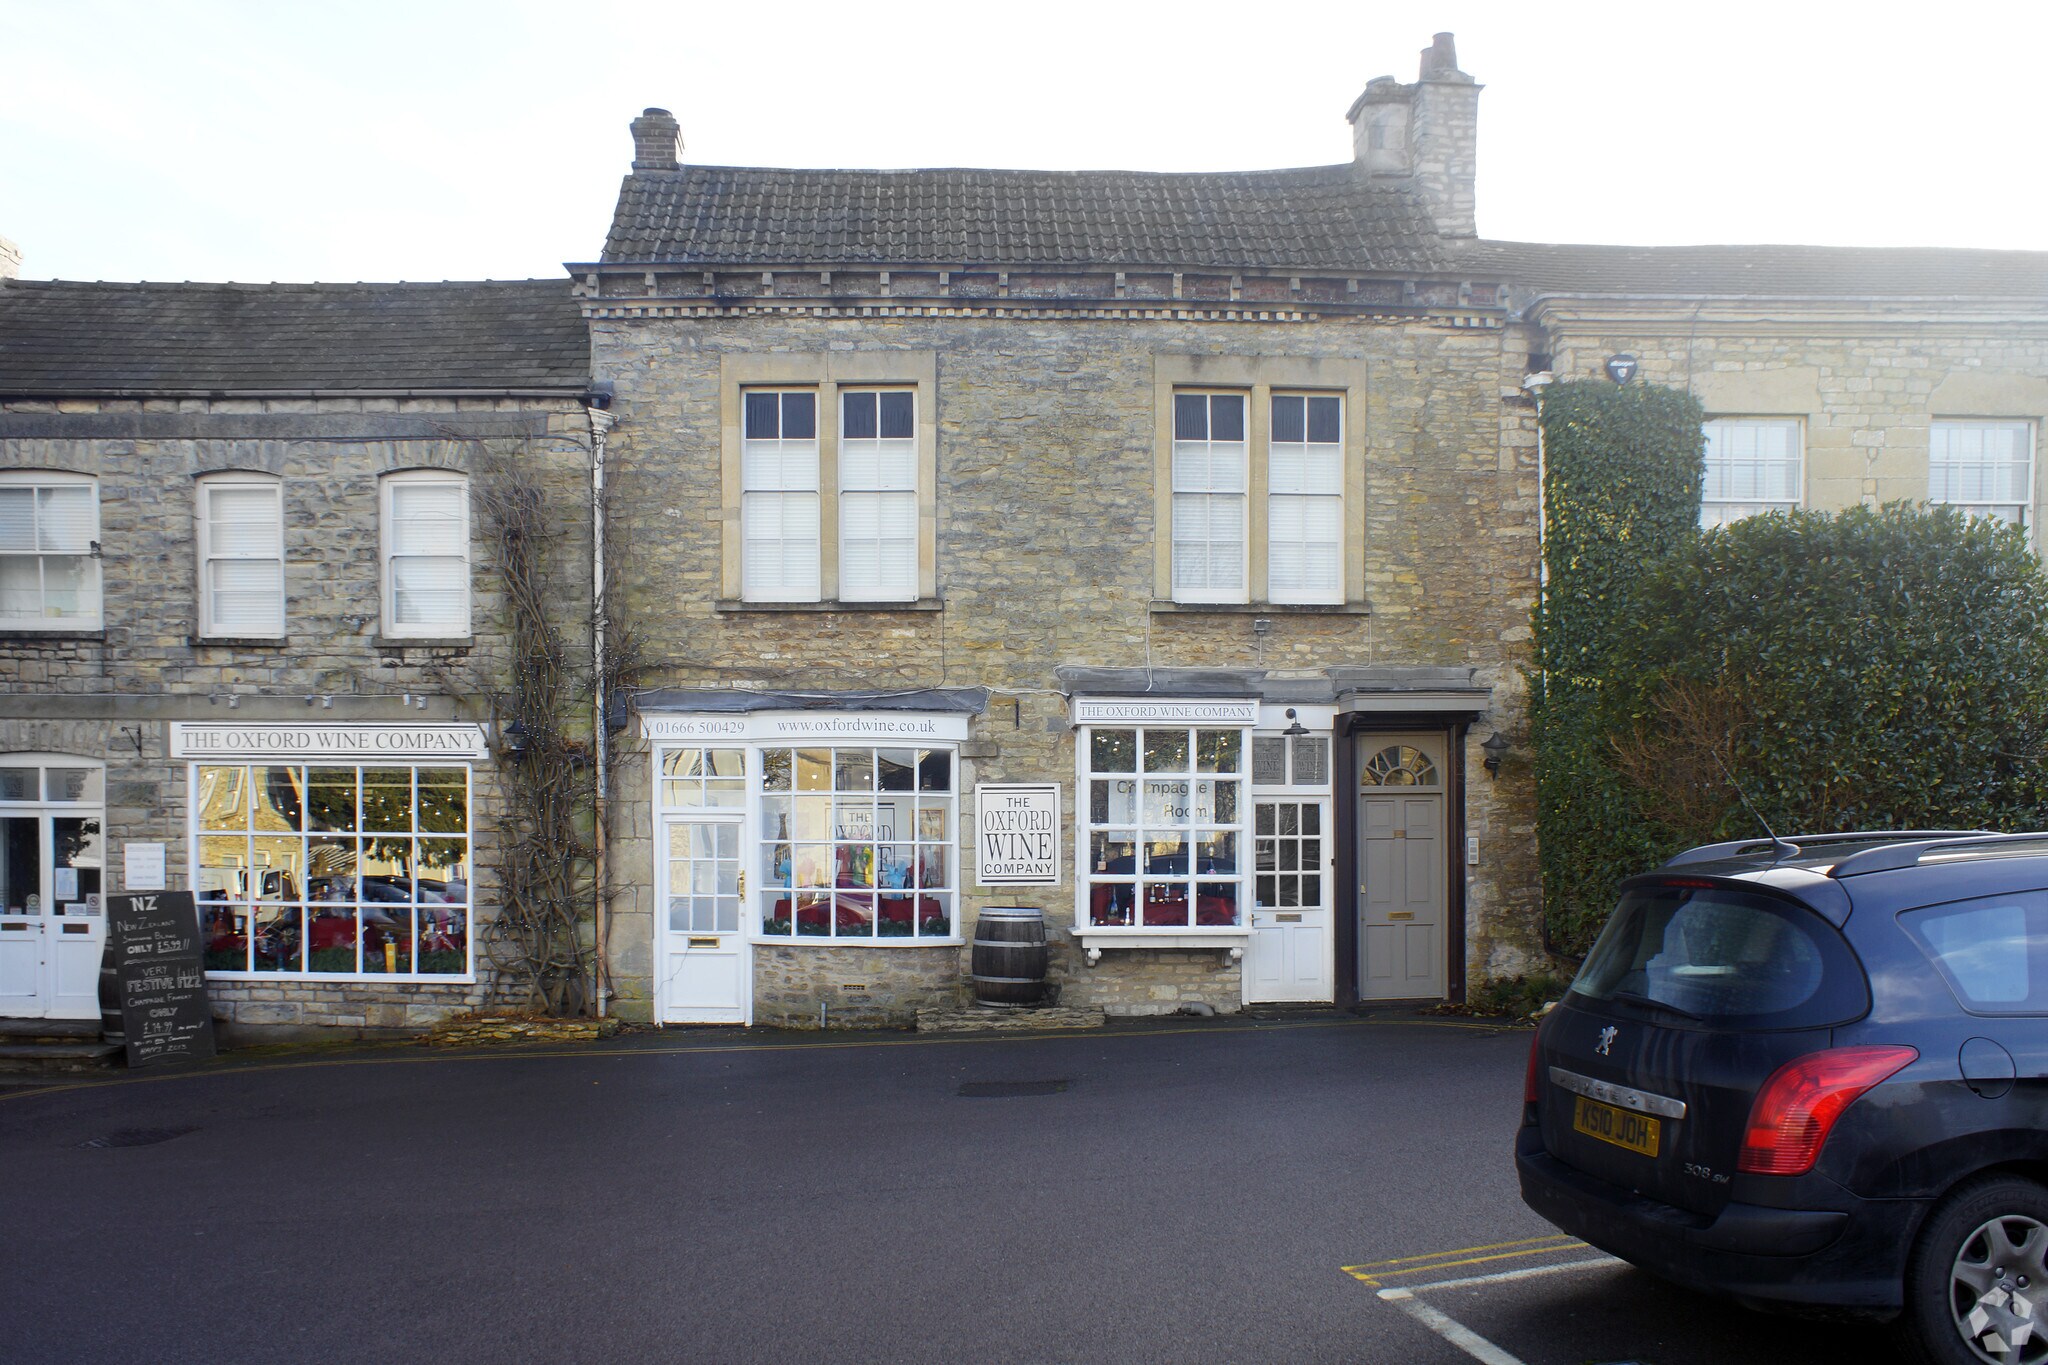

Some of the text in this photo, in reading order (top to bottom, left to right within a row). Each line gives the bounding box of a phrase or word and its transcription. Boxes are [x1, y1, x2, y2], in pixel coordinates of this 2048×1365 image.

[1079, 706, 1254, 717] THE OXFORD WINE COMPANY
[655, 721, 746, 734] 01666 500429
[777, 717, 936, 733] www.oxfordwine.co.uk
[181, 732, 477, 749] THE OXFORD WINE COMPANY
[1116, 780, 1208, 797] Chmpage
[1006, 797, 1030, 808] THE
[849, 812, 872, 822] THE
[984, 810, 1052, 831] OXFORD
[985, 832, 1052, 860] WINE
[984, 863, 1053, 874] COMPANY
[130, 895, 158, 912] NZ
[127, 944, 153, 954] ONLY
[142, 966, 168, 976] VERY
[126, 977, 176, 992] FESTIVE
[1581, 1102, 1613, 1137] KS10
[1684, 1162, 1711, 1179] 308
